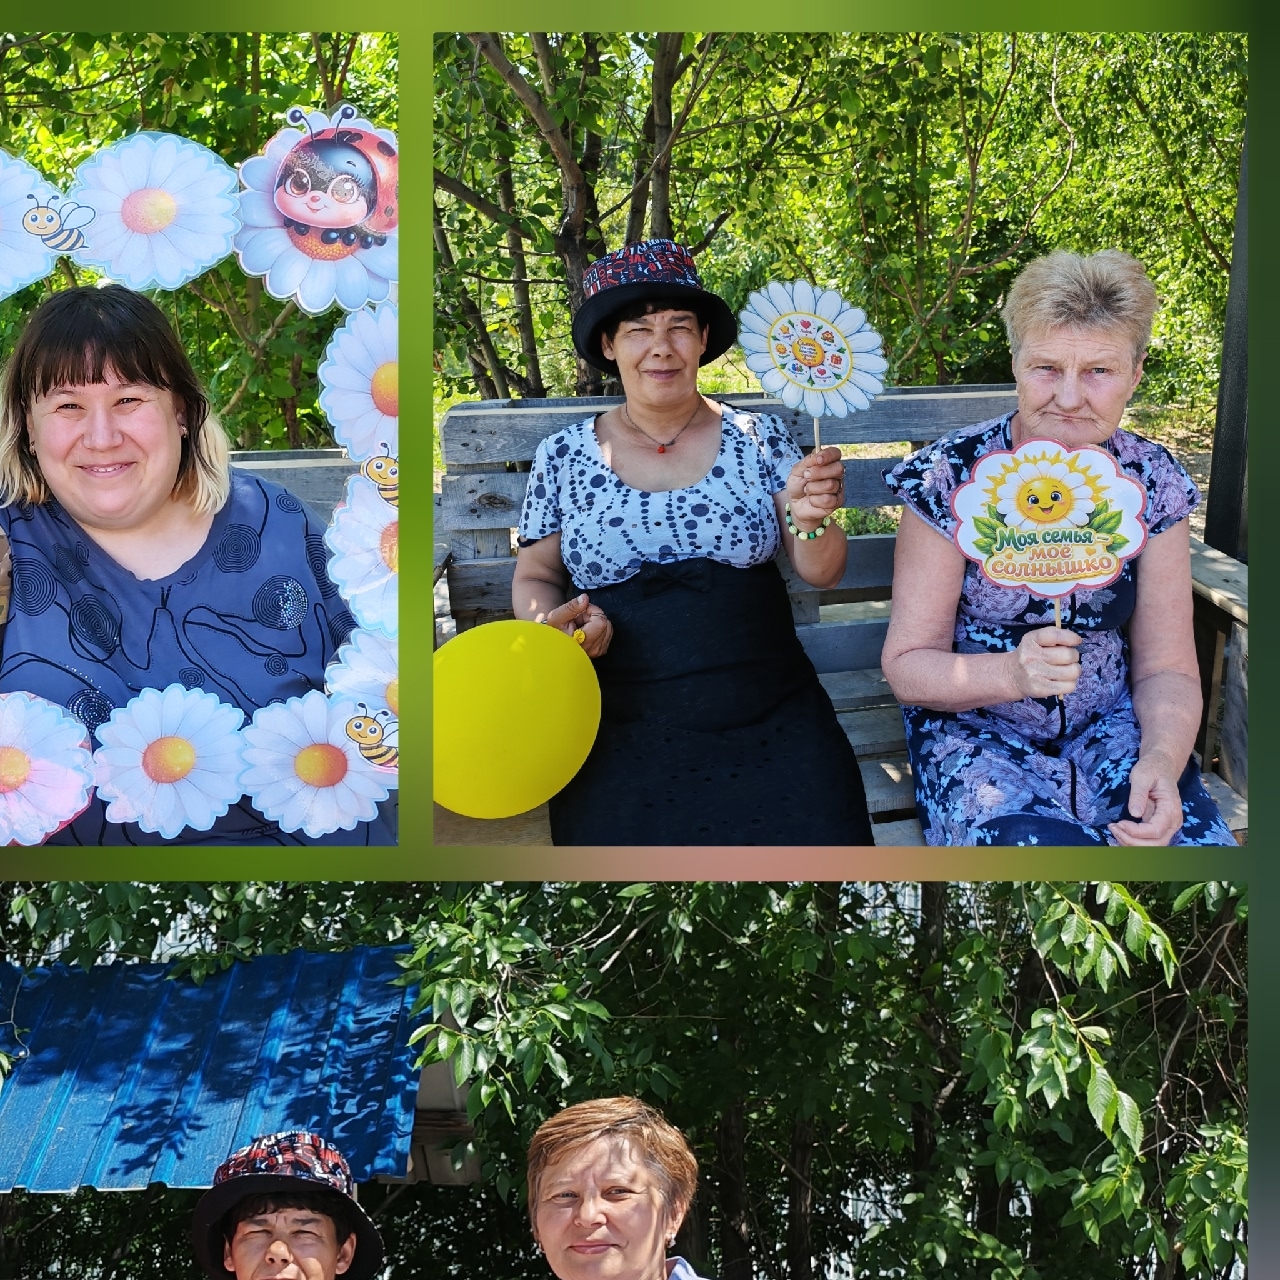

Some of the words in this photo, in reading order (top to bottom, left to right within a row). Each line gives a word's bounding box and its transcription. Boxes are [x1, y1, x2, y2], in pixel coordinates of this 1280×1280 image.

[996, 528, 1039, 551] Моя
[1042, 530, 1093, 545] семья
[1028, 544, 1072, 561] моё
[991, 556, 1112, 577] солнышко
